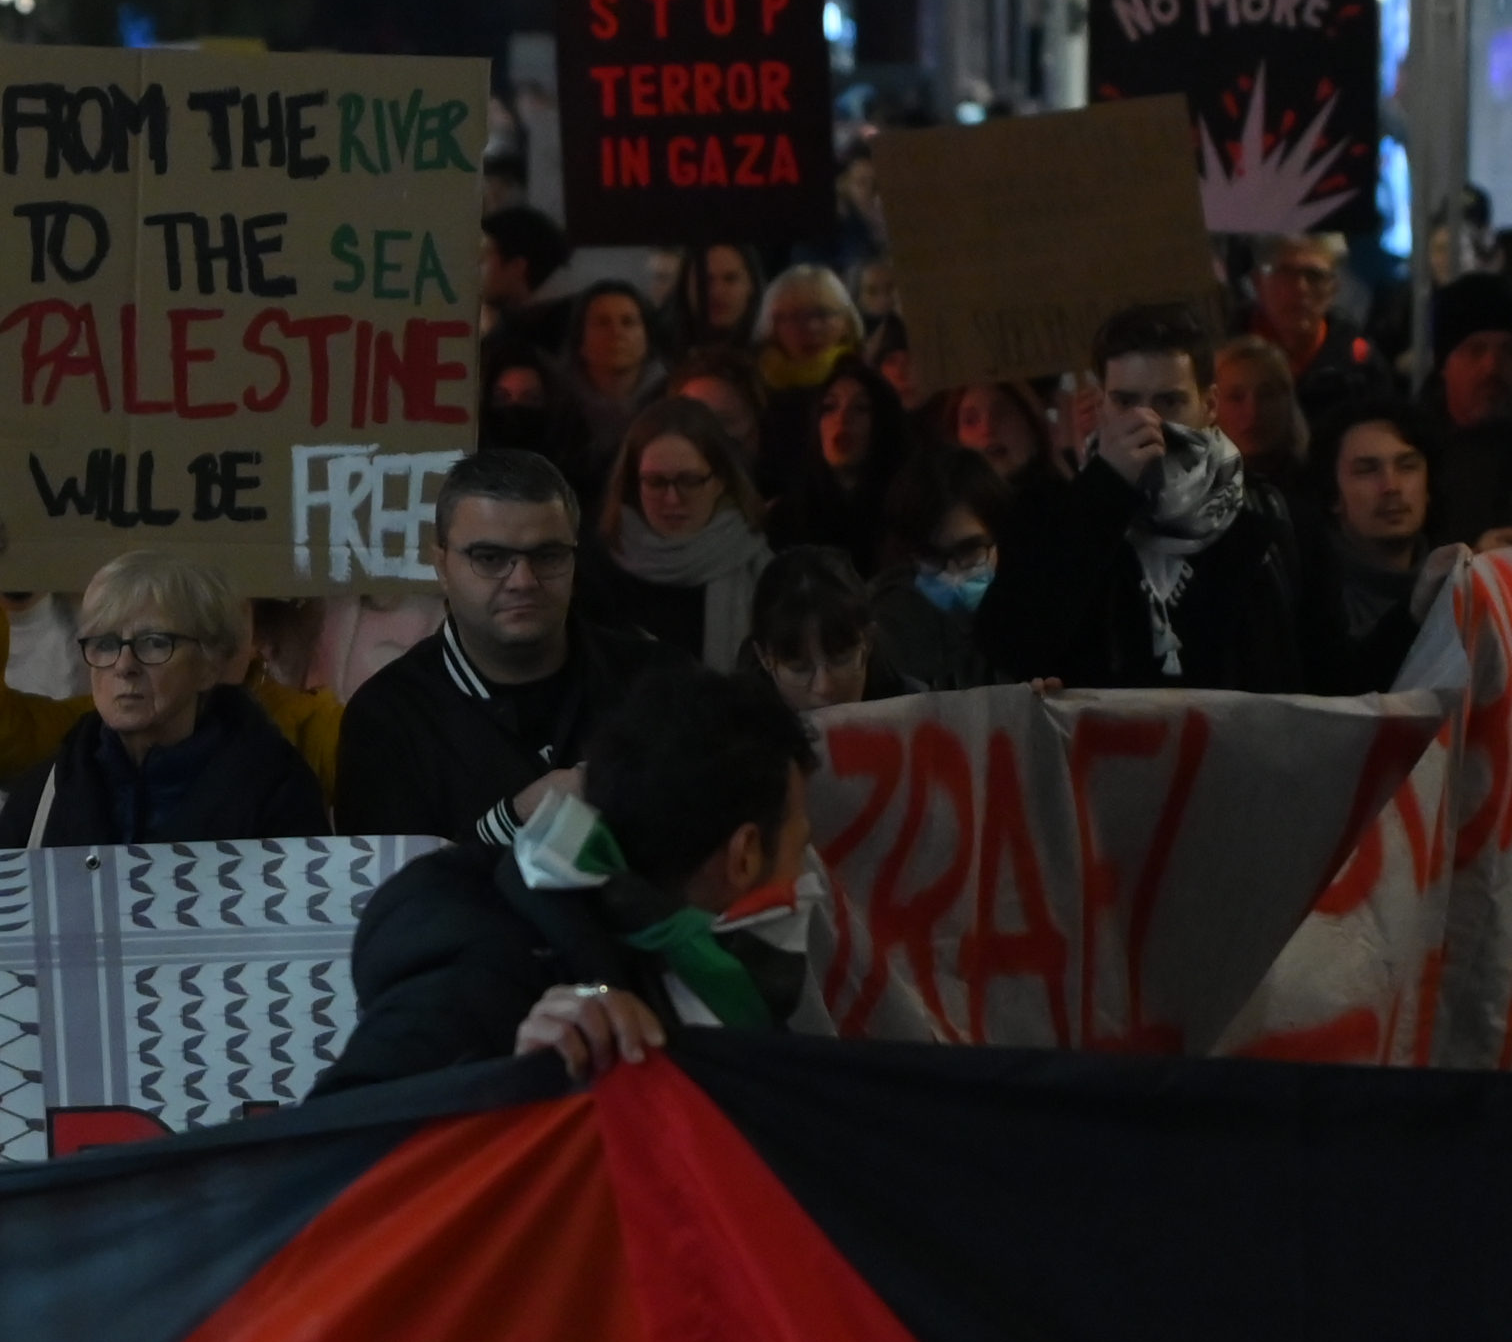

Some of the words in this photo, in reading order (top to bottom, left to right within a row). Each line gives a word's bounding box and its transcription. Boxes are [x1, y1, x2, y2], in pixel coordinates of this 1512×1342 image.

[2, 82, 170, 178] FROM
[187, 87, 330, 179] THE
[337, 88, 477, 174] RIVER
[589, 60, 792, 119] TERROR
[601, 134, 652, 188] IN
[666, 132, 801, 188] GAZA
[13, 201, 110, 284] TO
[144, 211, 297, 296] THE
[330, 223, 458, 306] SEA
[29, 448, 181, 527] WILL
[187, 450, 268, 522] BE
[290, 443, 466, 582] FREE
